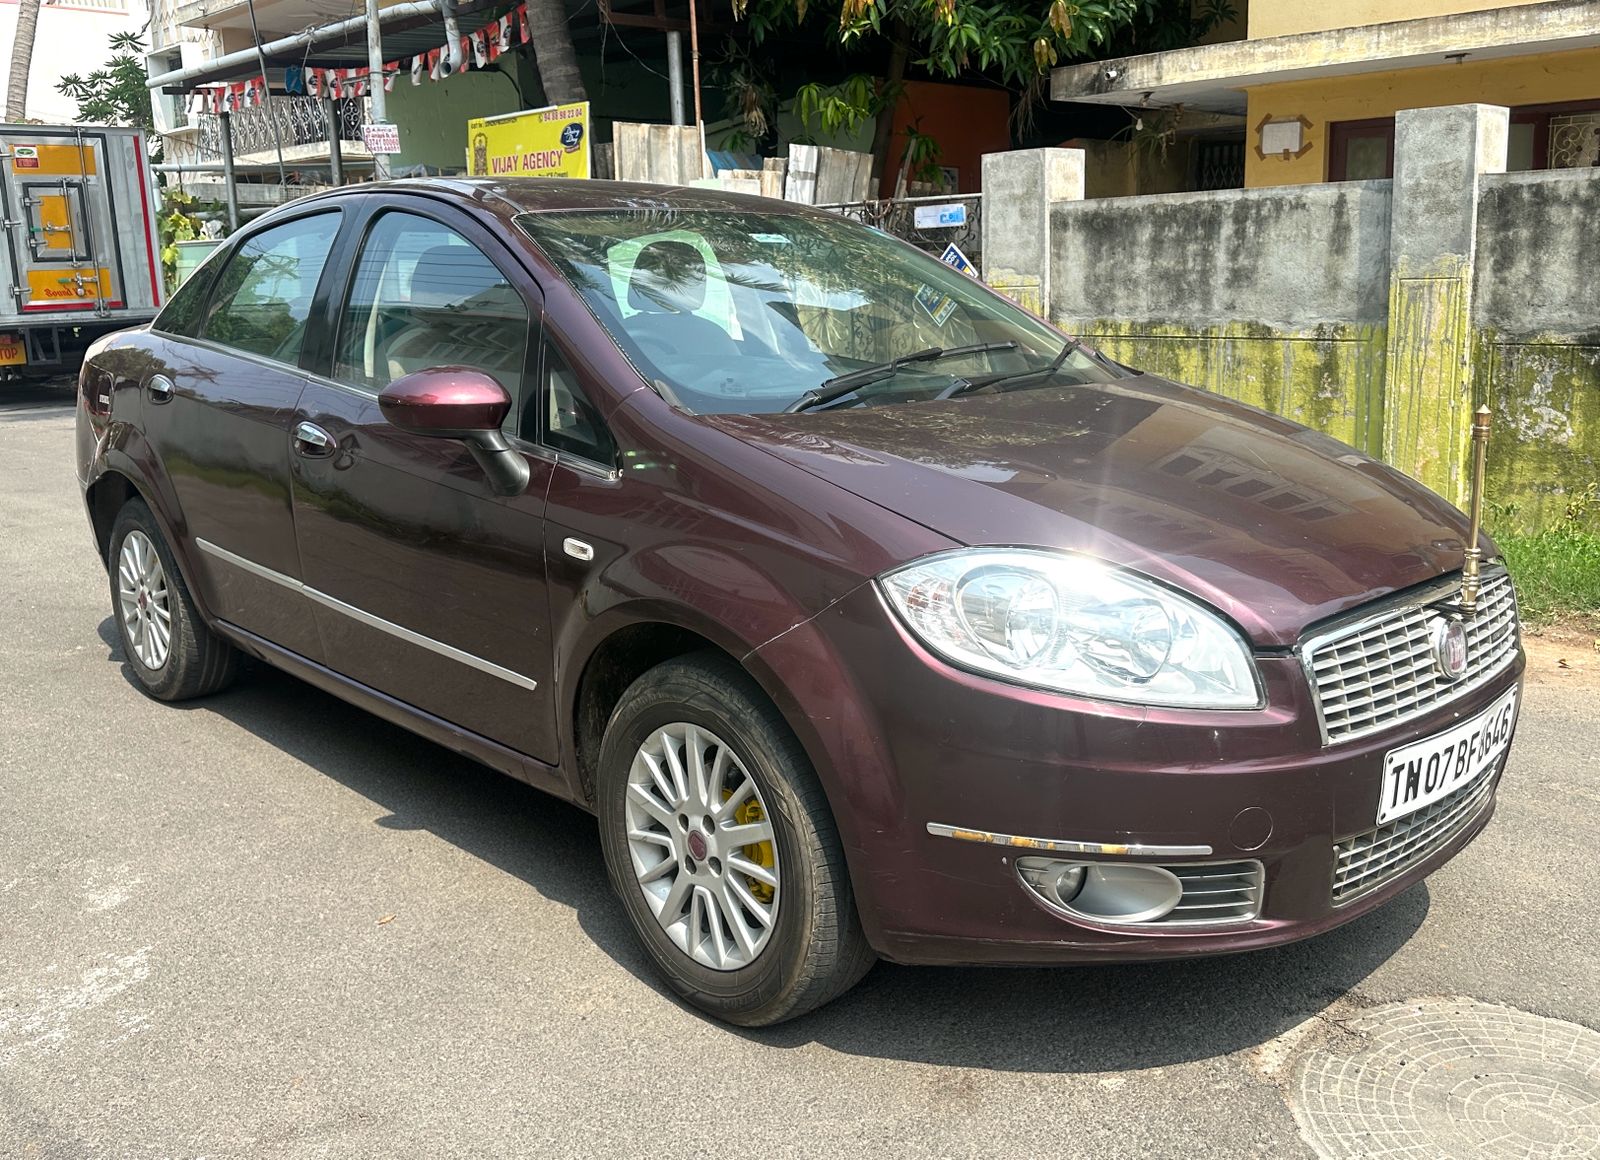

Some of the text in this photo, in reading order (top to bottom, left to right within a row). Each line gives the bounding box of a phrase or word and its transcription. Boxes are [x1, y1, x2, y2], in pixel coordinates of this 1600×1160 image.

[492, 150, 563, 174] VIJAY AGENCY
[1390, 702, 1512, 809] TN07BF8646
